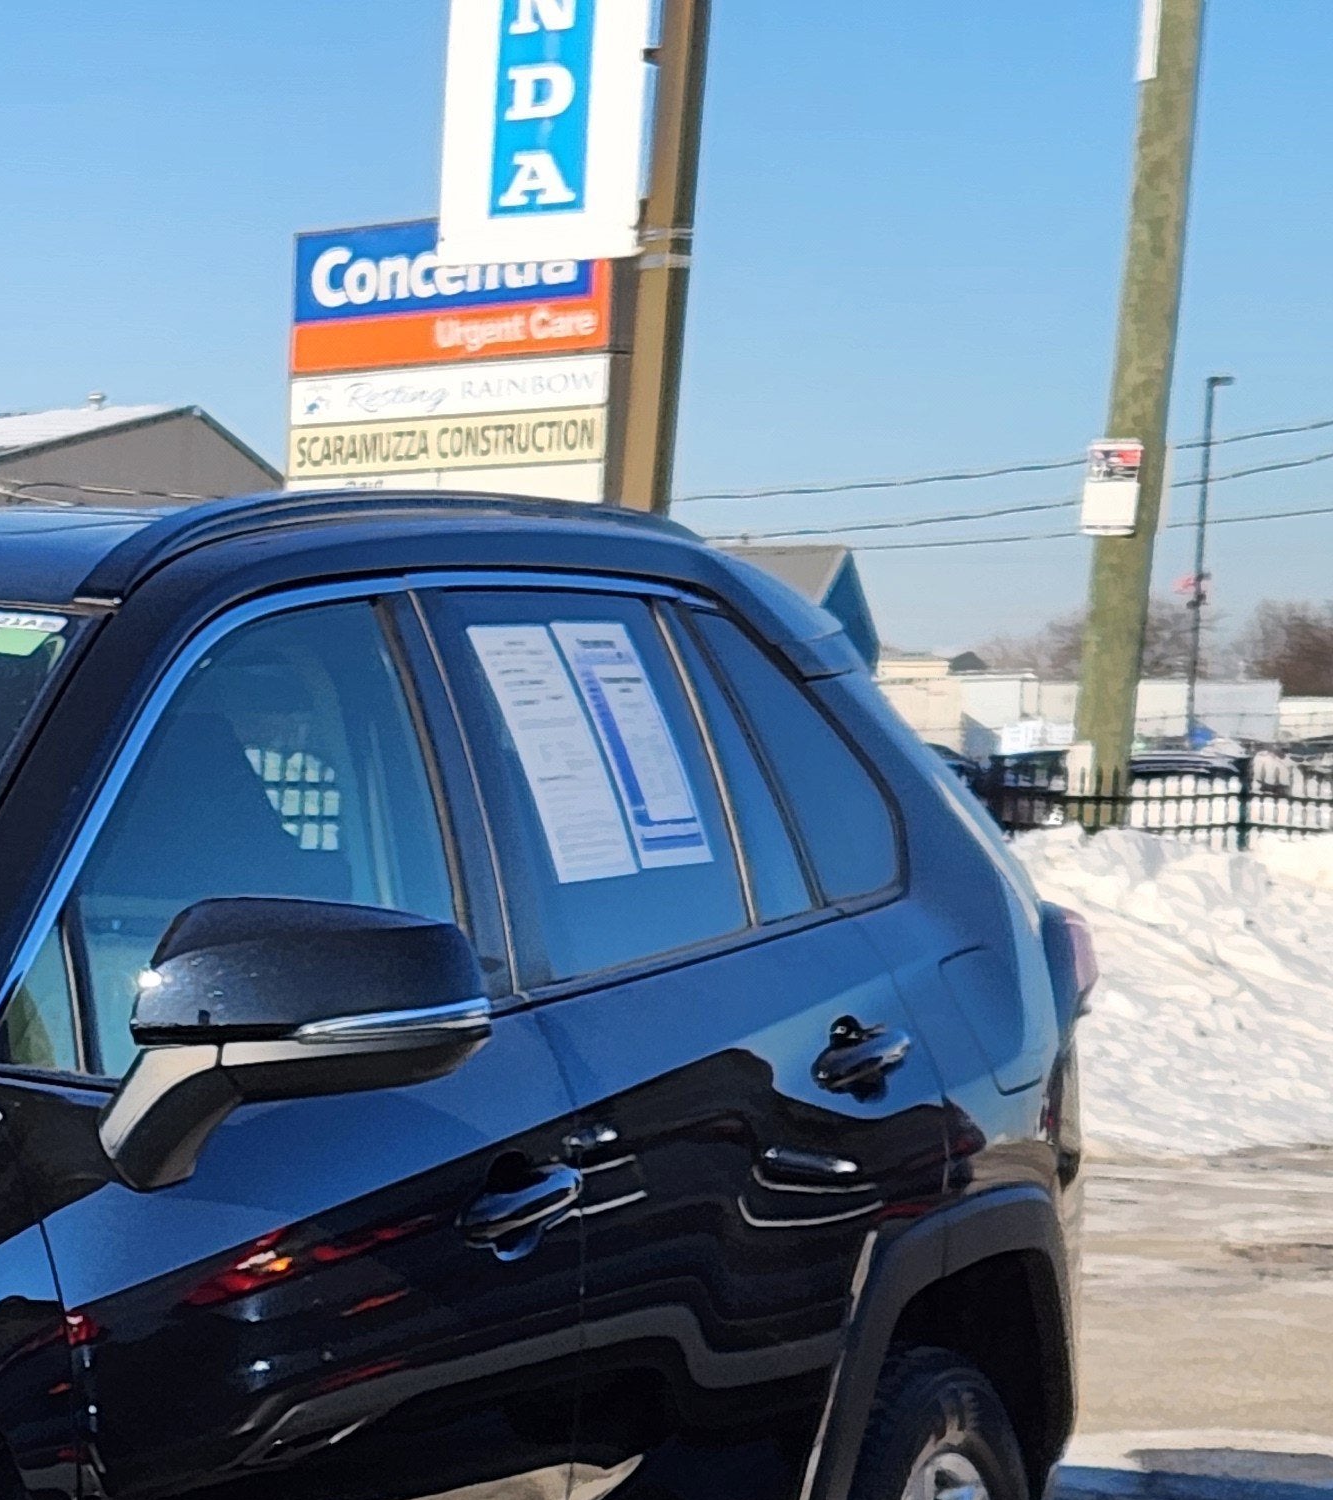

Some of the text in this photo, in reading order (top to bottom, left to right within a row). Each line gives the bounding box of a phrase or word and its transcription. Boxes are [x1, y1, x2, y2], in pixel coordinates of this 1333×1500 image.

[435, 307, 599, 351] Urgent Care
[461, 371, 599, 400] RAINBOW
[296, 418, 596, 468] SCARAMUZZA CONSTRUCTION
